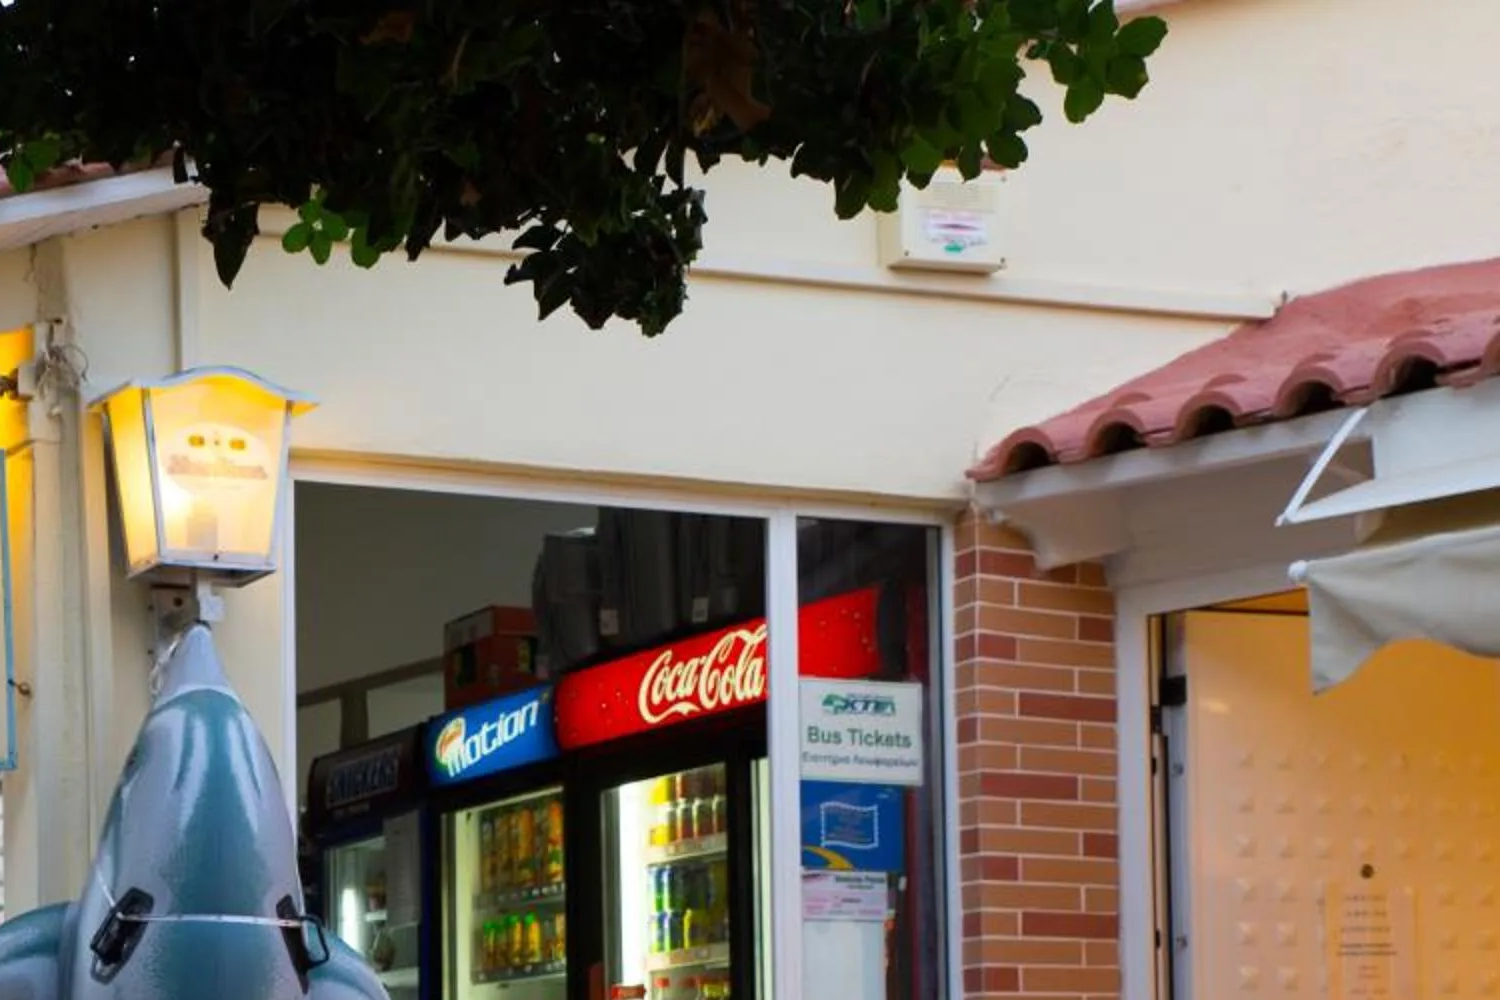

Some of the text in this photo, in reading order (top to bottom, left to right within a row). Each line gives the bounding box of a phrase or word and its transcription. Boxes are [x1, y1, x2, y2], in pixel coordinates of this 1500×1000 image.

[638, 623, 768, 724] Coca-Cola
[807, 725, 912, 749] Bus Tickets
